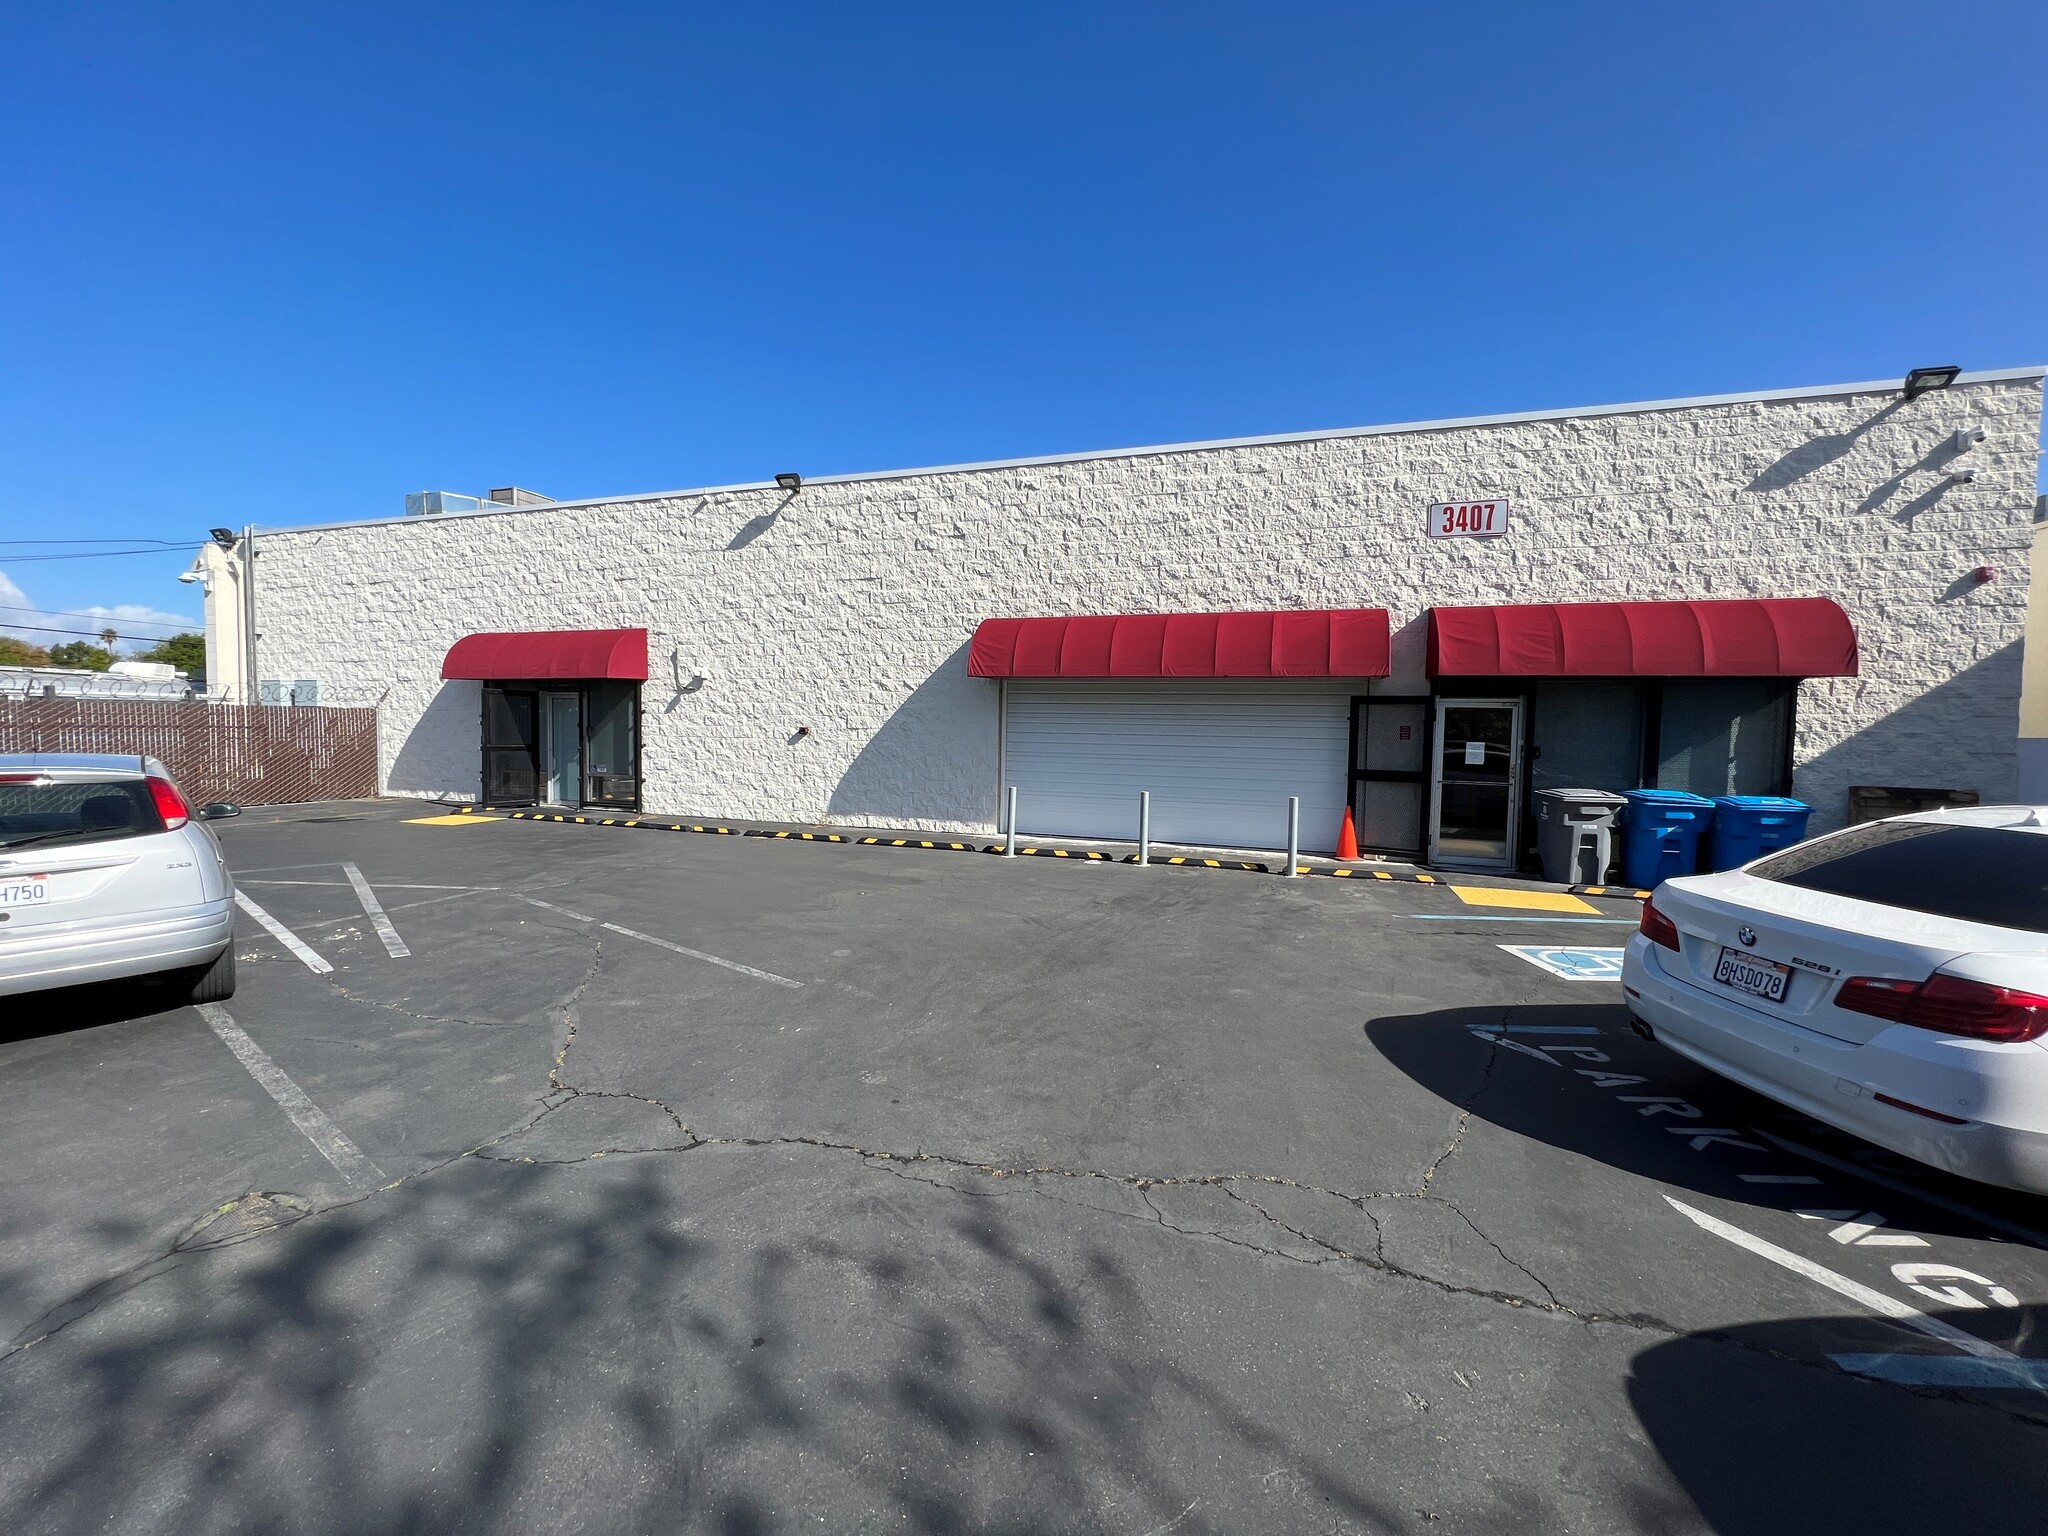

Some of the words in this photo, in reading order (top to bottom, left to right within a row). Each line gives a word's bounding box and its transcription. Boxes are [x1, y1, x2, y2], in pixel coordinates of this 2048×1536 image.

[1442, 504, 1496, 534] 3407
[166, 861, 192, 870] ZX3
[1720, 960, 1782, 995] 8HSD078
[1540, 1045, 2020, 1309] PARKING
